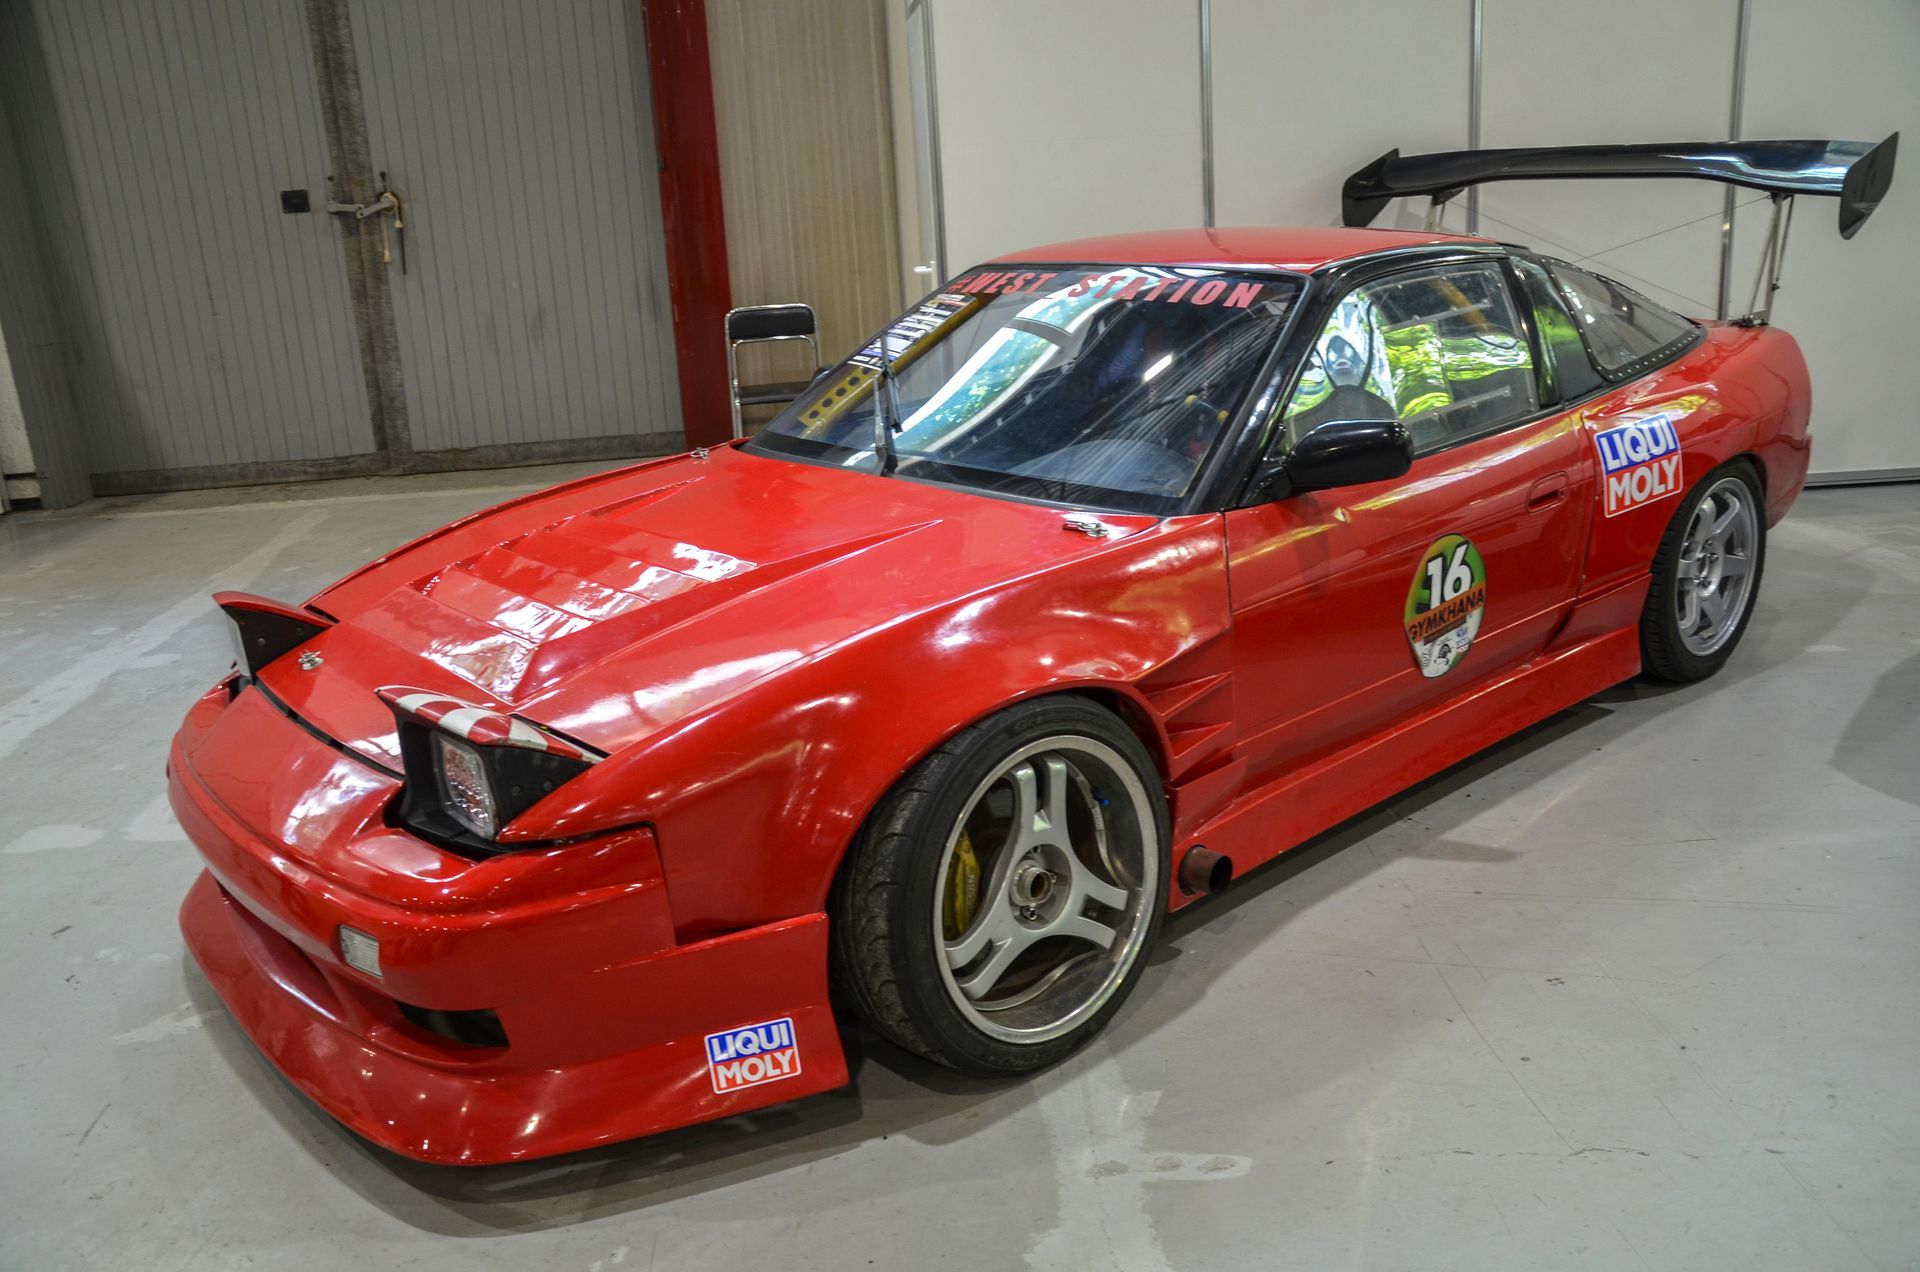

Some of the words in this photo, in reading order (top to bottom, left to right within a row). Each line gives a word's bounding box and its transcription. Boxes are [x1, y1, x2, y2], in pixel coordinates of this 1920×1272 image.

[1599, 418, 1676, 471] LIQUI
[1608, 455, 1679, 511] MOLY
[1426, 542, 1472, 609] 16
[1409, 588, 1484, 640] GYMKHANA
[710, 1022, 790, 1062] LIQUI
[716, 1048, 793, 1089] MOLY
